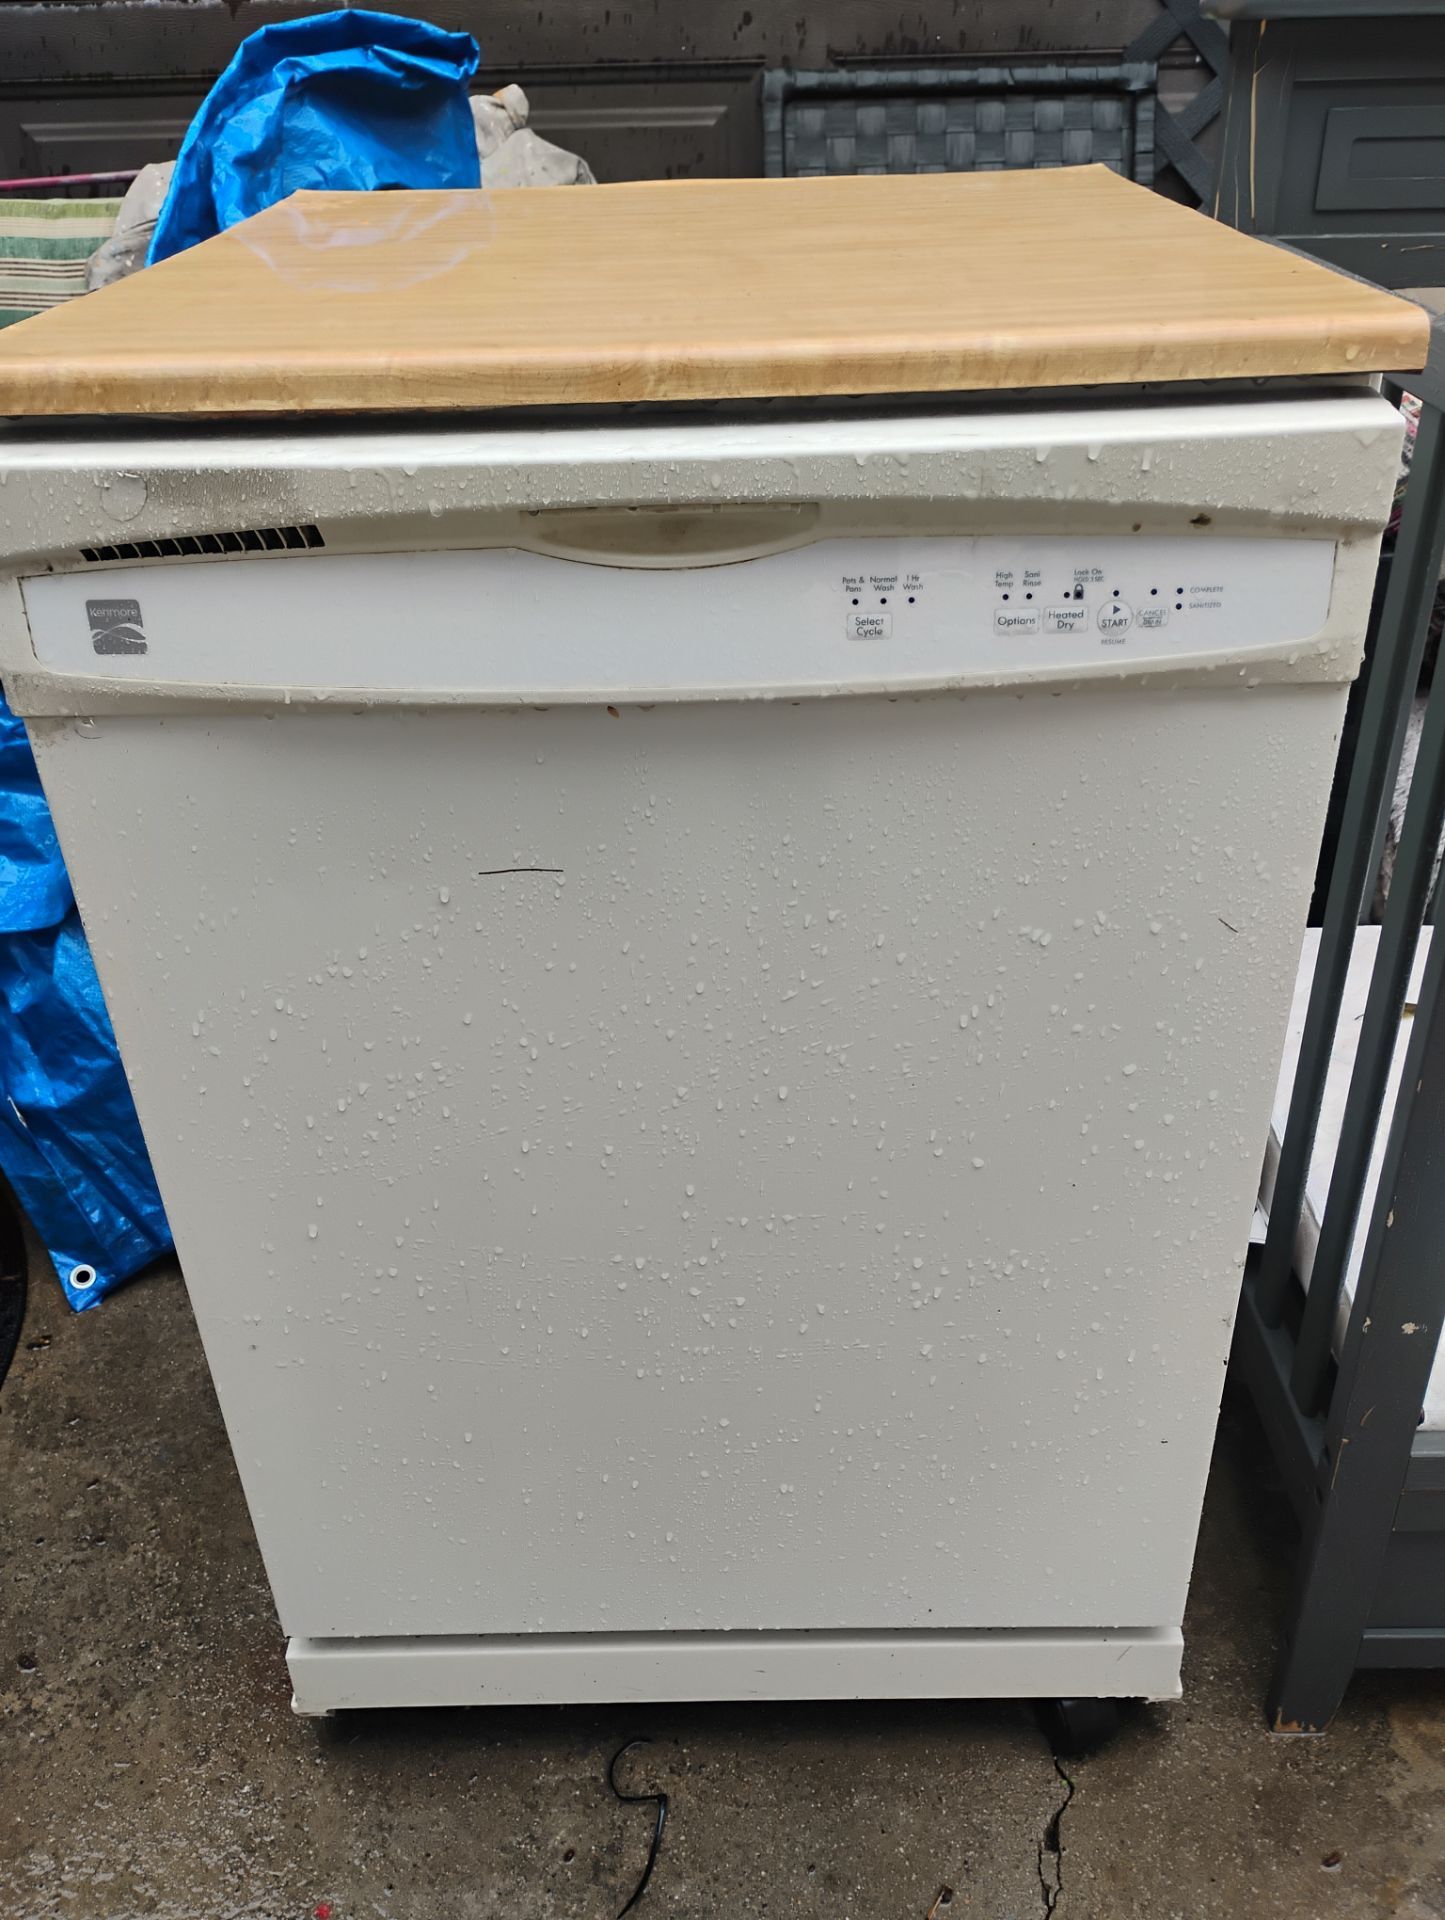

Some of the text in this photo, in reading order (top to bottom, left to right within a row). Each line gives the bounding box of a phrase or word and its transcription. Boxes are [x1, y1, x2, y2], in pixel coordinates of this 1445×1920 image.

[995, 571, 1014, 580] High
[1024, 570, 1041, 578] Sani
[1073, 567, 1102, 576] Lock On
[842, 576, 864, 584] Pots &
[869, 575, 898, 584] Normal
[911, 574, 920, 582] Hr
[845, 585, 862, 593] Pans
[873, 584, 895, 592] Wash
[902, 583, 924, 592] Wash
[995, 580, 1014, 589] Temp
[1189, 586, 1224, 594] COMPLETE
[89, 607, 138, 617] Kenmore
[1048, 609, 1084, 619] Heated
[855, 616, 884, 626] Select
[997, 616, 1035, 627] Options
[1056, 620, 1075, 630] Dry
[1101, 618, 1127, 629] START
[856, 626, 883, 637] Cycle
